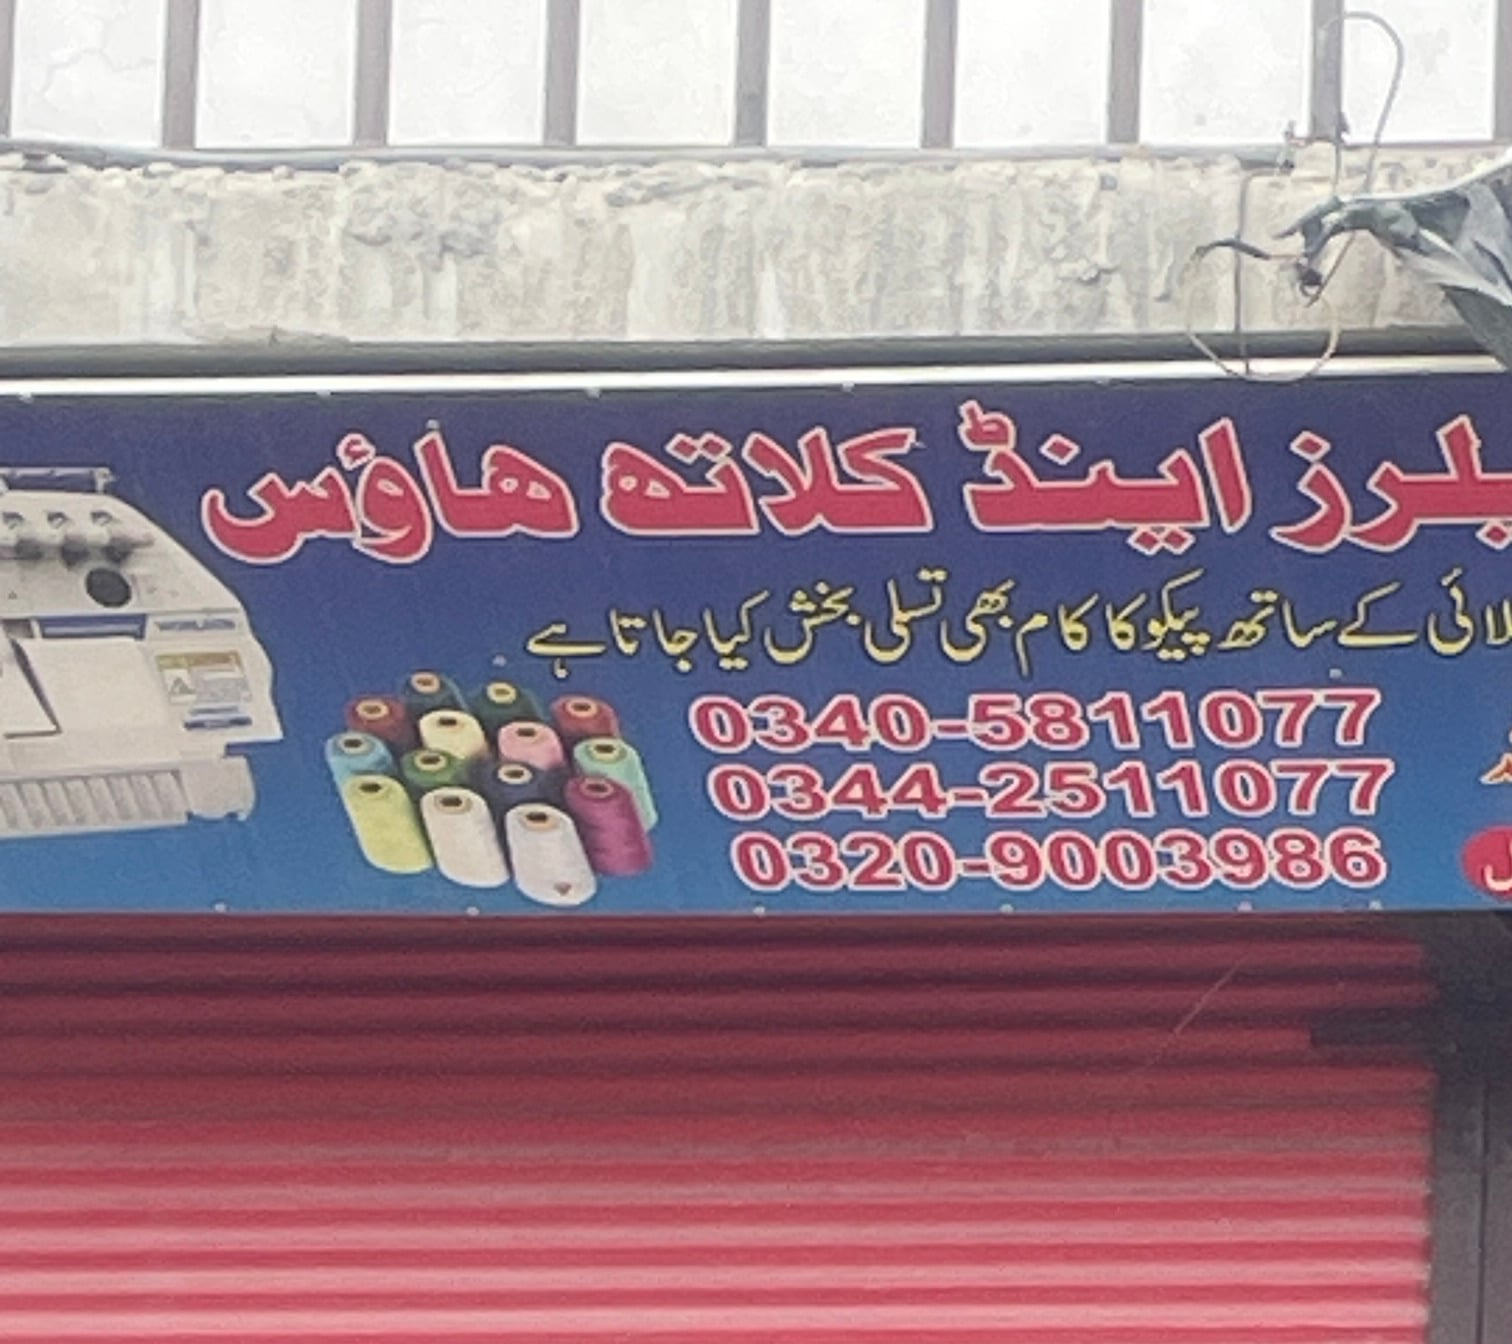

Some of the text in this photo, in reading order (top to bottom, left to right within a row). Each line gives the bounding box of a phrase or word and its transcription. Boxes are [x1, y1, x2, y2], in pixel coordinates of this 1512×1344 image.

[958, 400, 1252, 554] اینڈ
[1014, 592, 1099, 678] کام
[1105, 592, 1147, 651] کا
[1337, 582, 1419, 647] کے
[689, 688, 1381, 752] 0340-5811077
[707, 757, 1395, 819] 0344-2511077
[730, 827, 1387, 892] 0320-9003986
